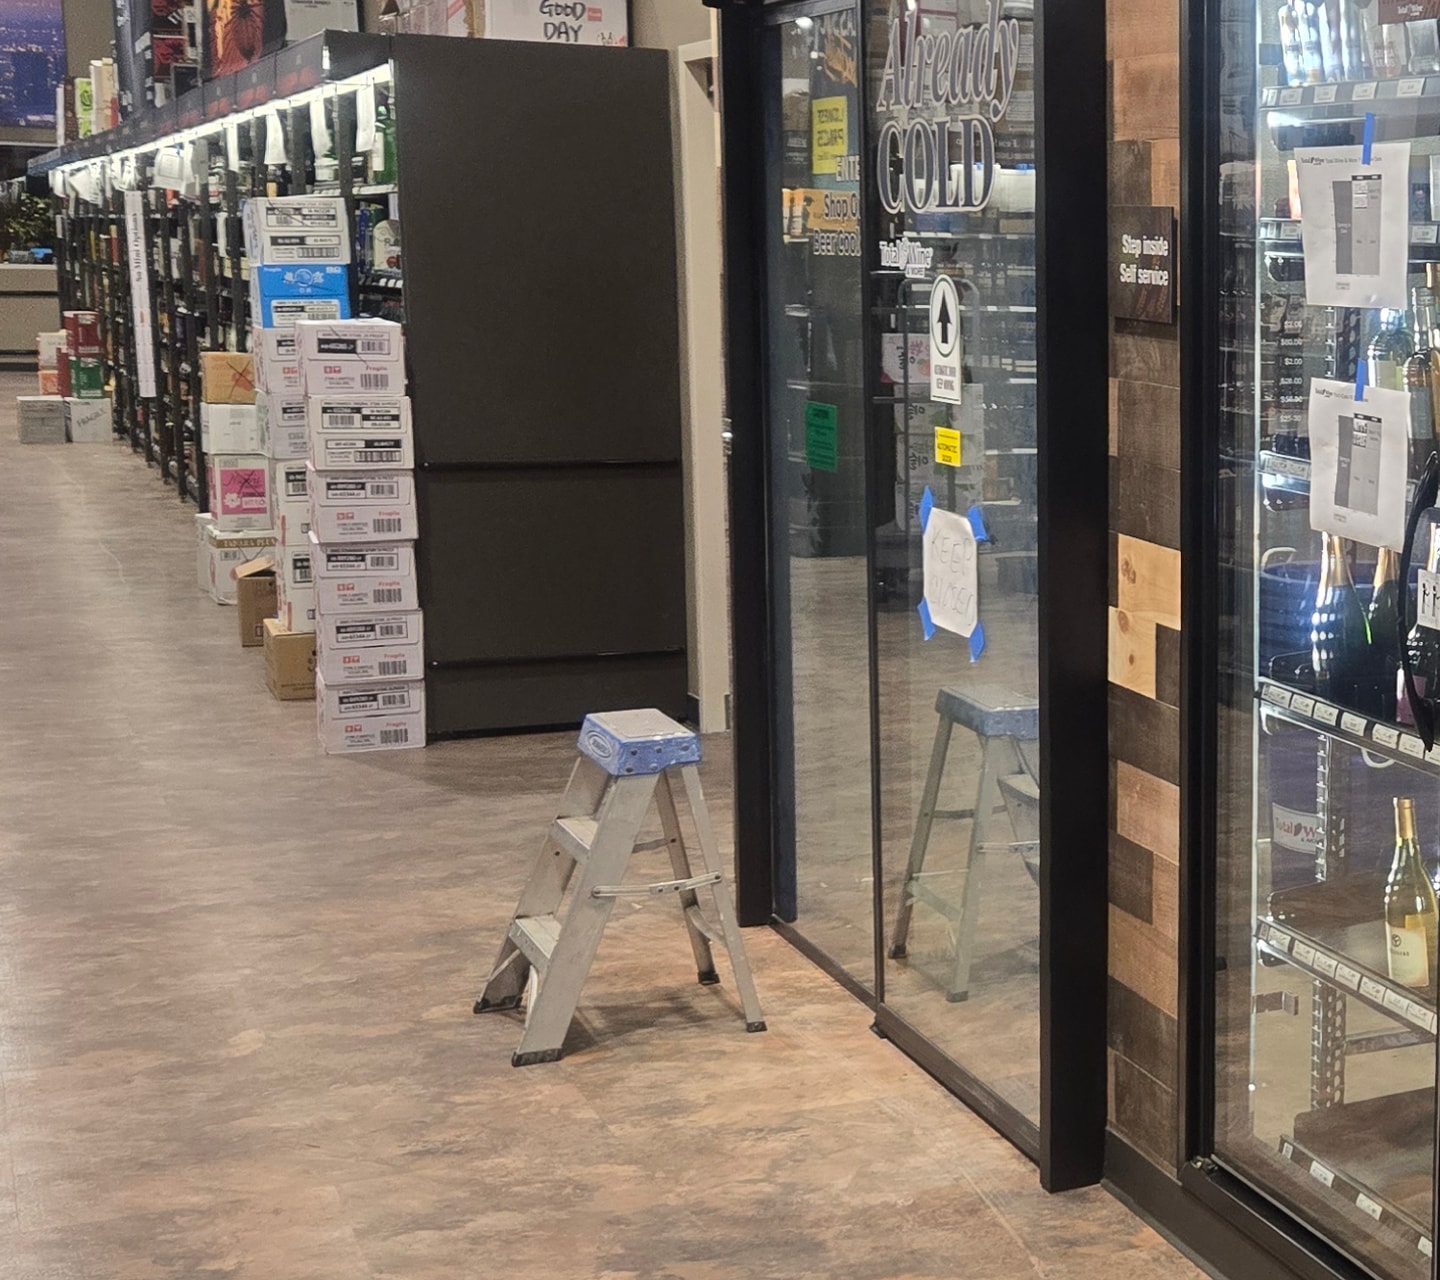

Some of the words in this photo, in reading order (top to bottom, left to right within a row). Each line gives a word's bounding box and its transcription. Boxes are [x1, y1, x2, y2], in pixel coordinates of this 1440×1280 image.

[543, 22, 582, 43] DAY
[876, 114, 996, 215] COLD
[824, 192, 852, 220] Shop
[812, 230, 836, 256] Beer
[879, 240, 900, 267] Total
[1122, 234, 1142, 258] Step
[1143, 235, 1168, 256] inside
[1120, 263, 1137, 283] Self
[1138, 266, 1168, 286] service
